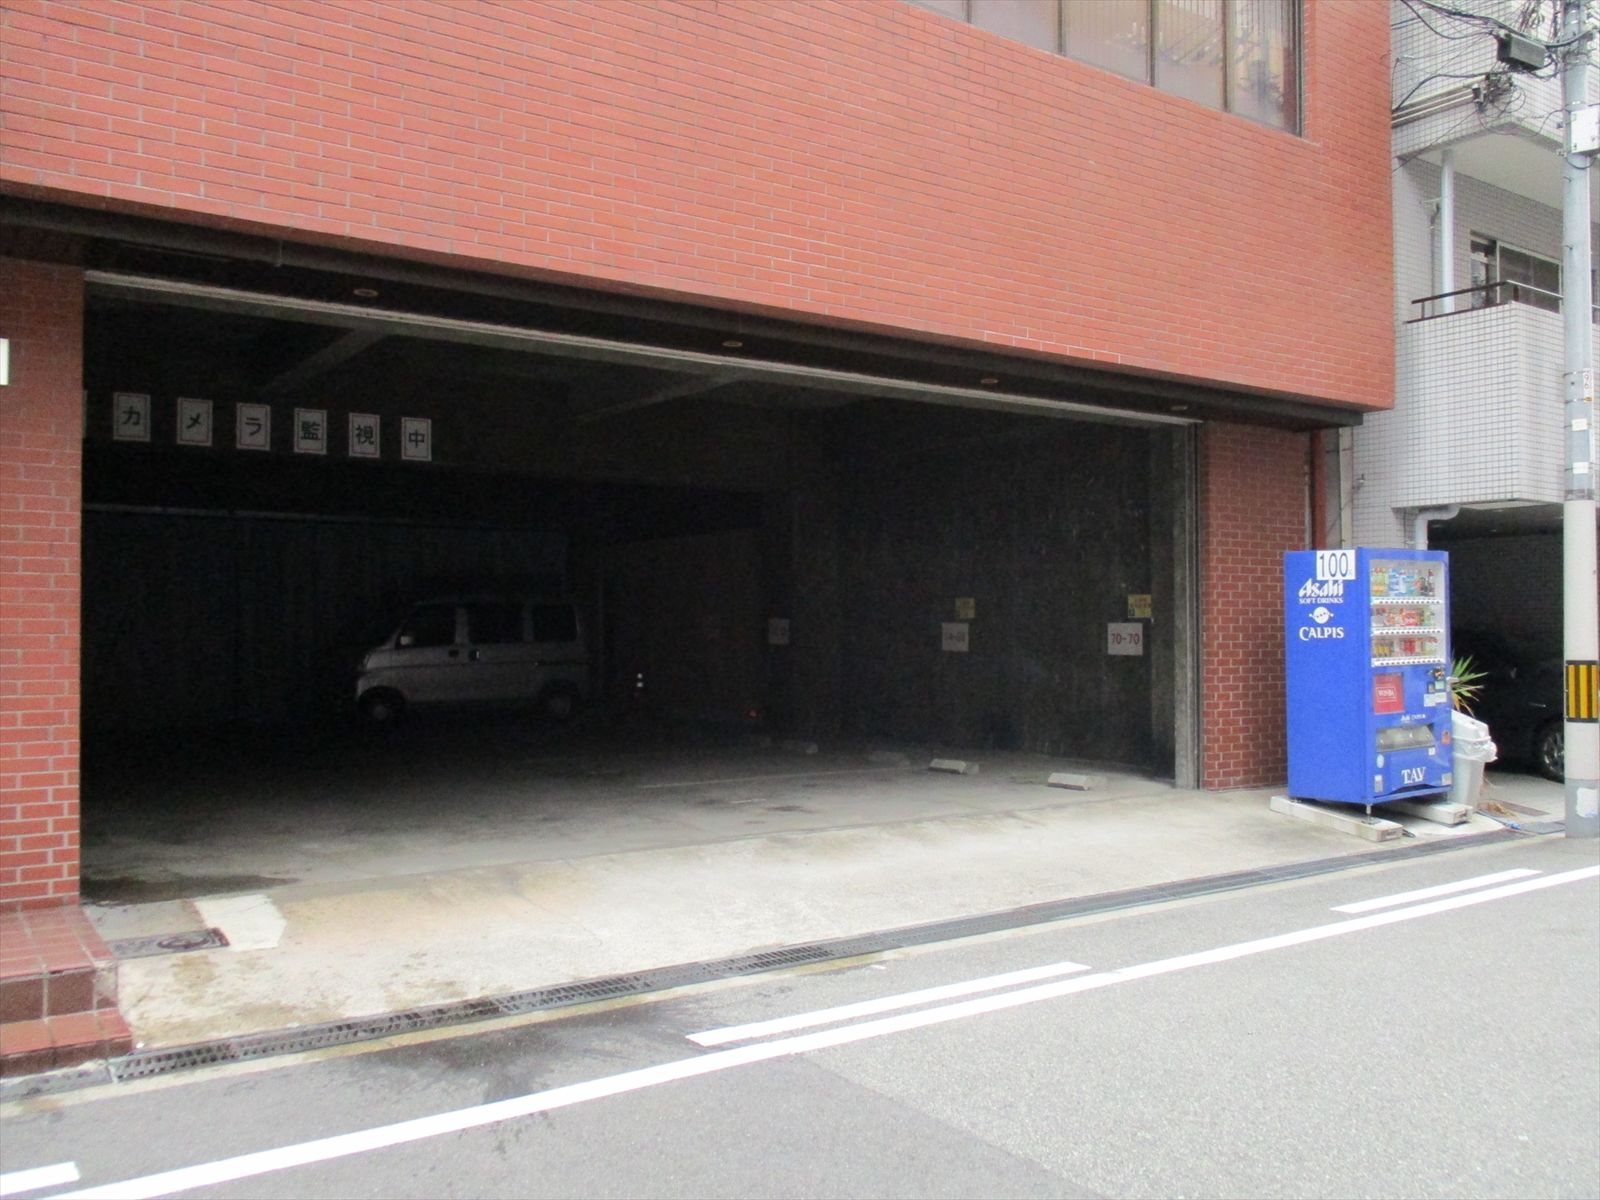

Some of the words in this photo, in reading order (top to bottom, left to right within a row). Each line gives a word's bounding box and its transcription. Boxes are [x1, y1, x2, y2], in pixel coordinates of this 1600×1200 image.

[122, 407, 425, 447] カメラ監視中
[1320, 552, 1348, 577] 100
[1299, 578, 1343, 598] Asahi
[1111, 632, 1140, 645] 70-70
[1299, 626, 1344, 641] CALPIS
